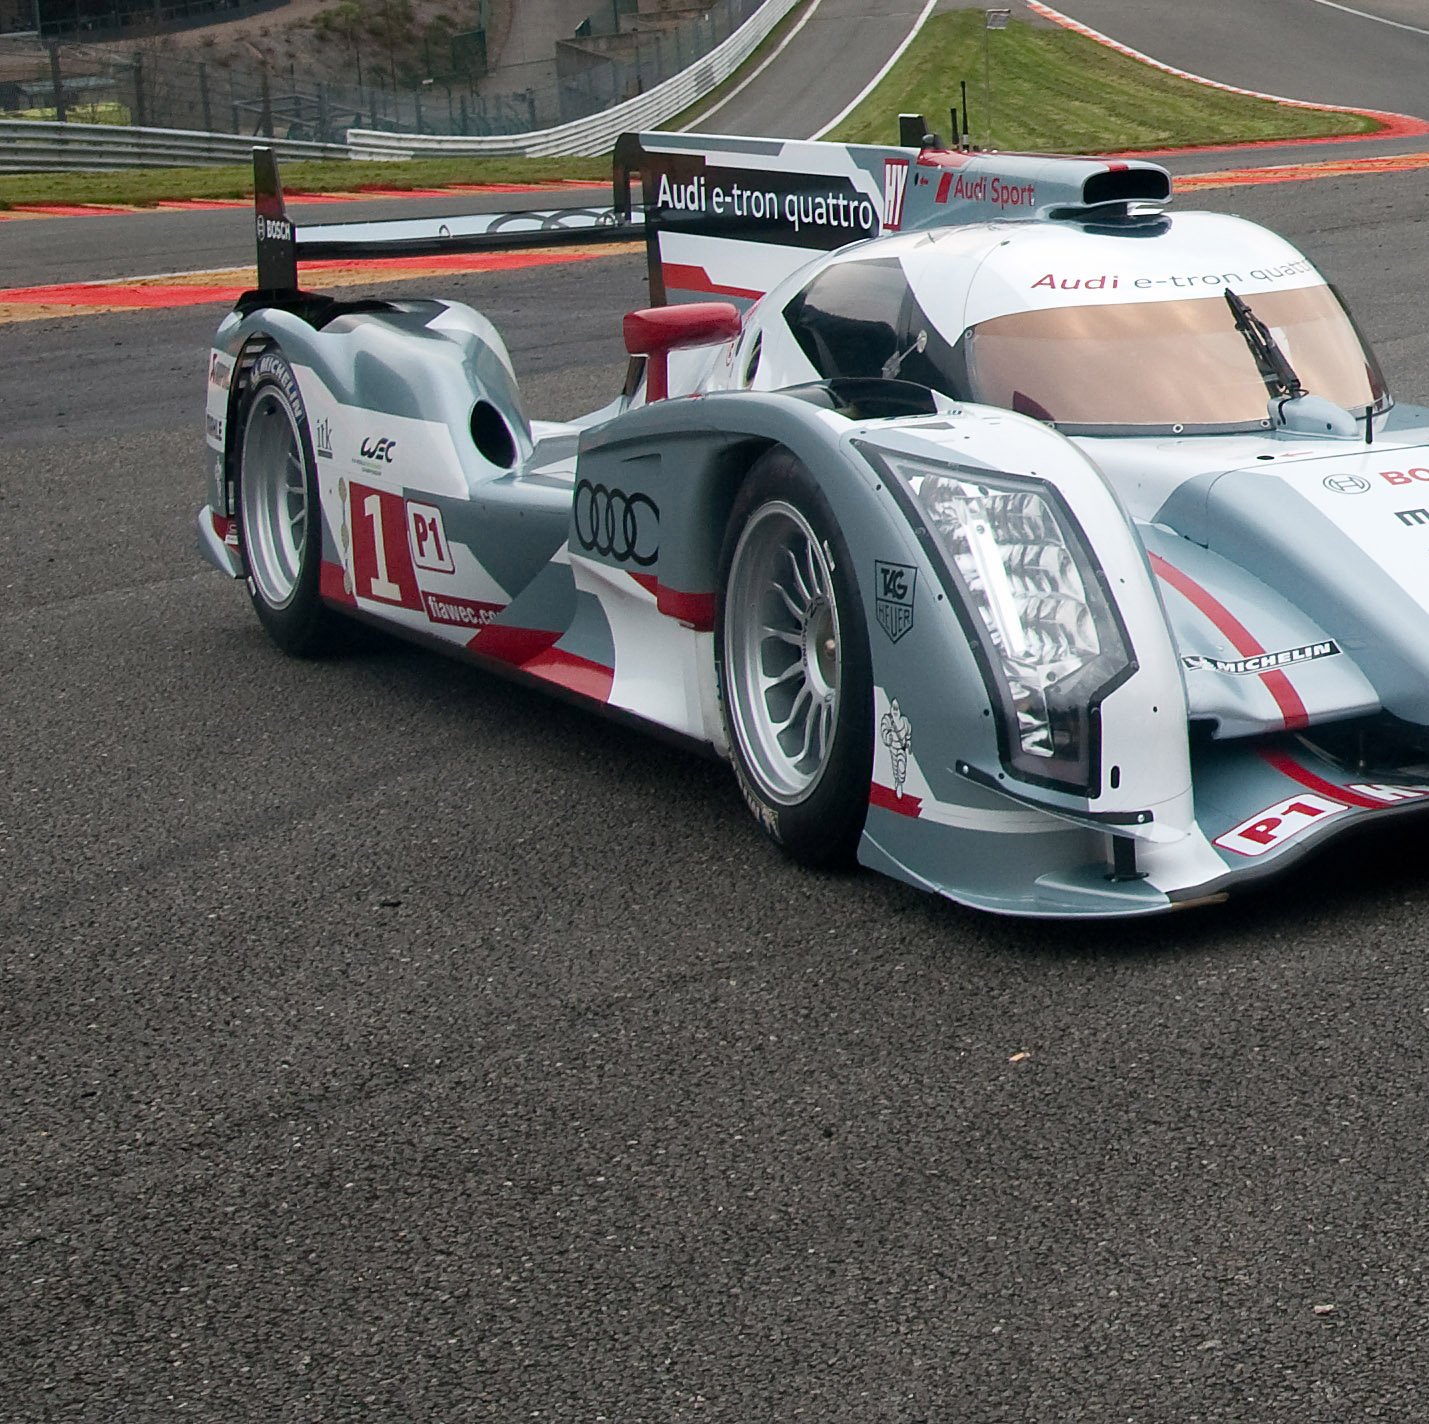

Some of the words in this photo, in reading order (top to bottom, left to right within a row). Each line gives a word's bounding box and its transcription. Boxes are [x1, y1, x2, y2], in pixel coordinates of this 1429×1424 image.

[657, 174, 706, 212] Audi
[712, 183, 778, 220] e-tron
[785, 192, 873, 232] quattro
[884, 164, 909, 225] HY
[954, 175, 987, 201] Audi
[991, 178, 1035, 210] Sport
[266, 220, 291, 241] BOSCH
[1031, 273, 1119, 289] Audi
[1134, 271, 1244, 289] e-tron
[261, 355, 303, 422] MICHELIN
[317, 417, 333, 451] itk
[360, 437, 396, 464] WEC
[364, 494, 402, 601] 1
[413, 513, 445, 562] P1
[881, 568, 908, 600] TAG
[428, 596, 500, 625] fiawec.co
[879, 605, 911, 637] HEUER
[1216, 642, 1331, 673] MICHELIN
[1238, 801, 1327, 845] P1
